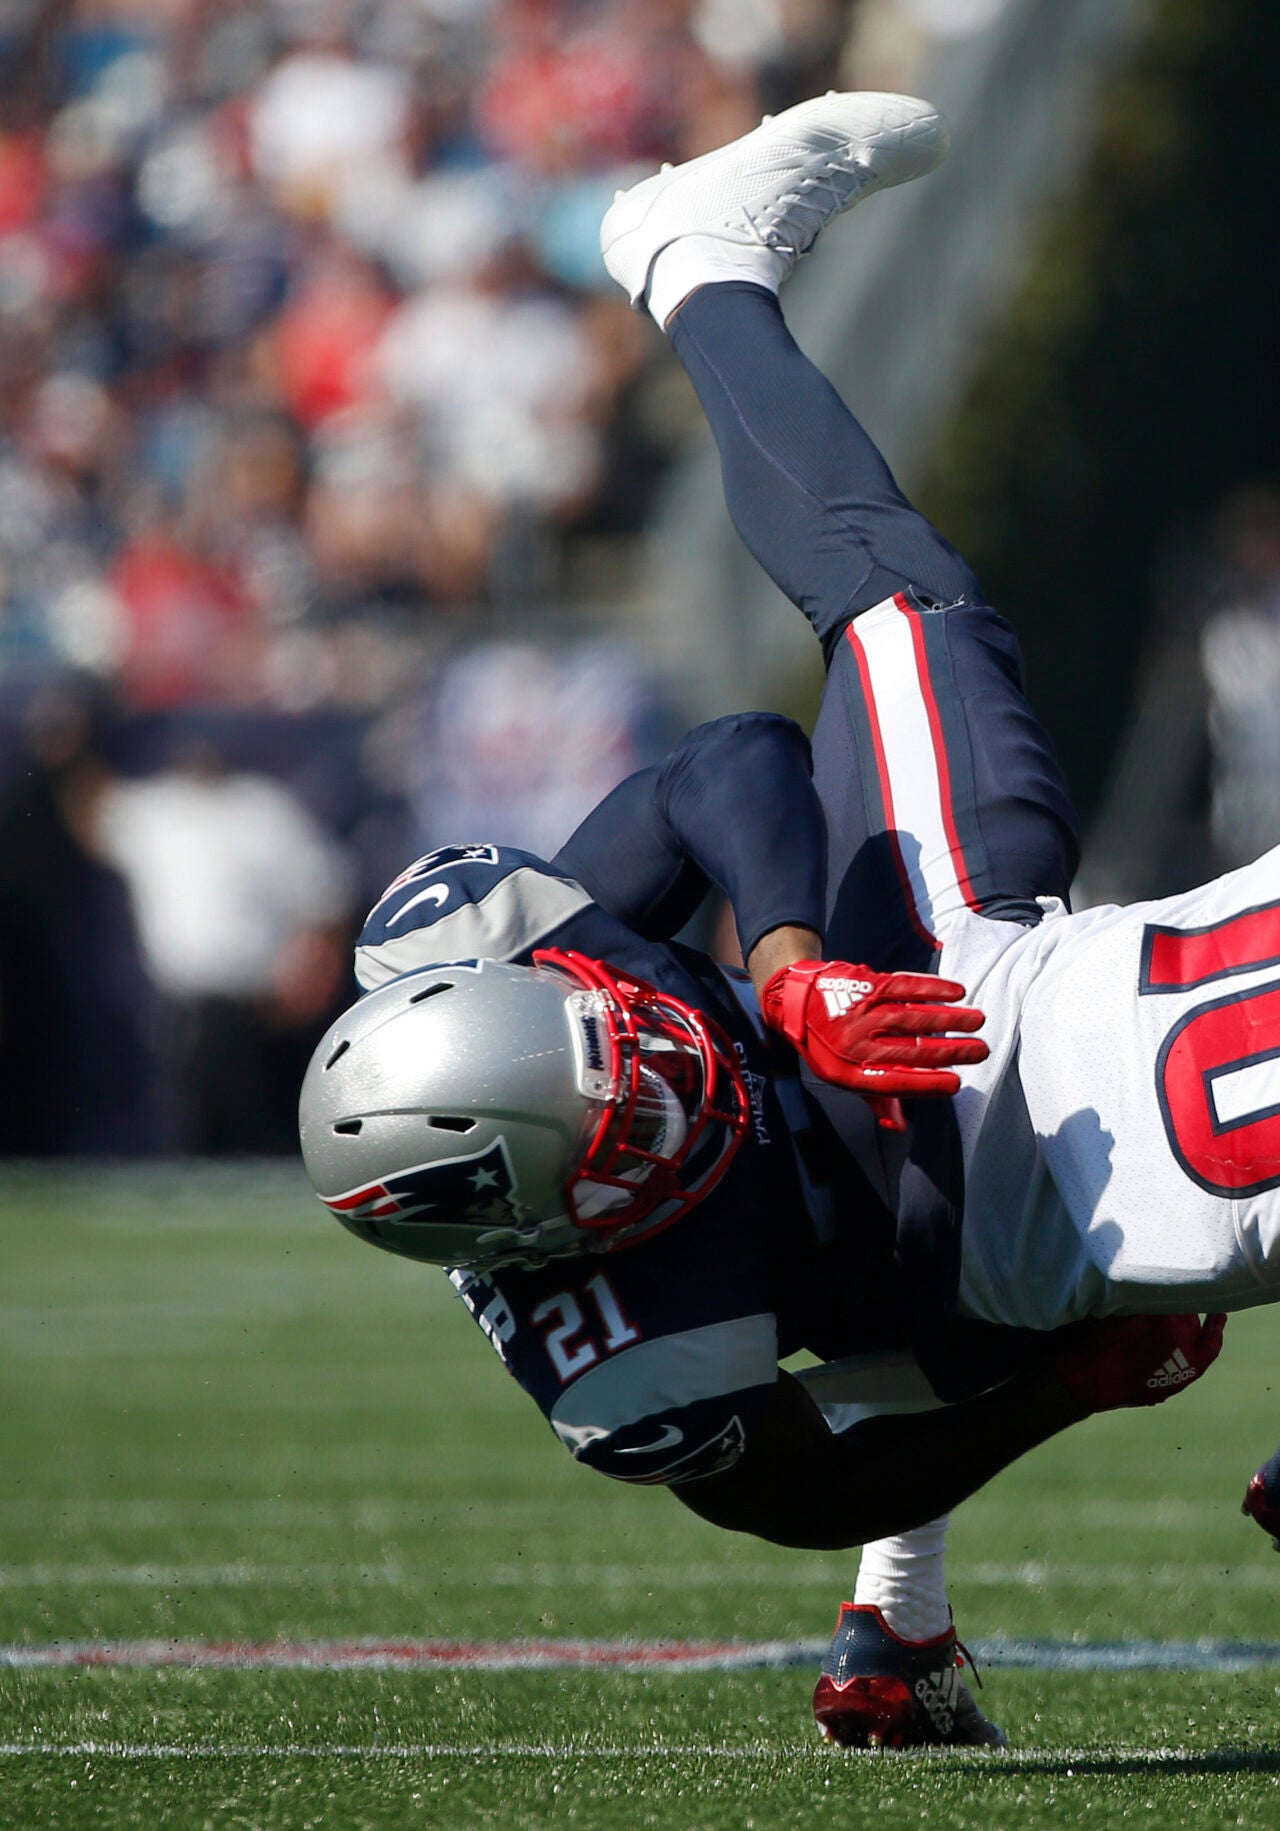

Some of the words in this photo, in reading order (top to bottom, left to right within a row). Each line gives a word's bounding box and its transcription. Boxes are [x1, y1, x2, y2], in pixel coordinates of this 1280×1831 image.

[816, 976, 874, 994] adidas
[530, 1271, 643, 1385] 21
[1145, 1367, 1197, 1389] adidas
